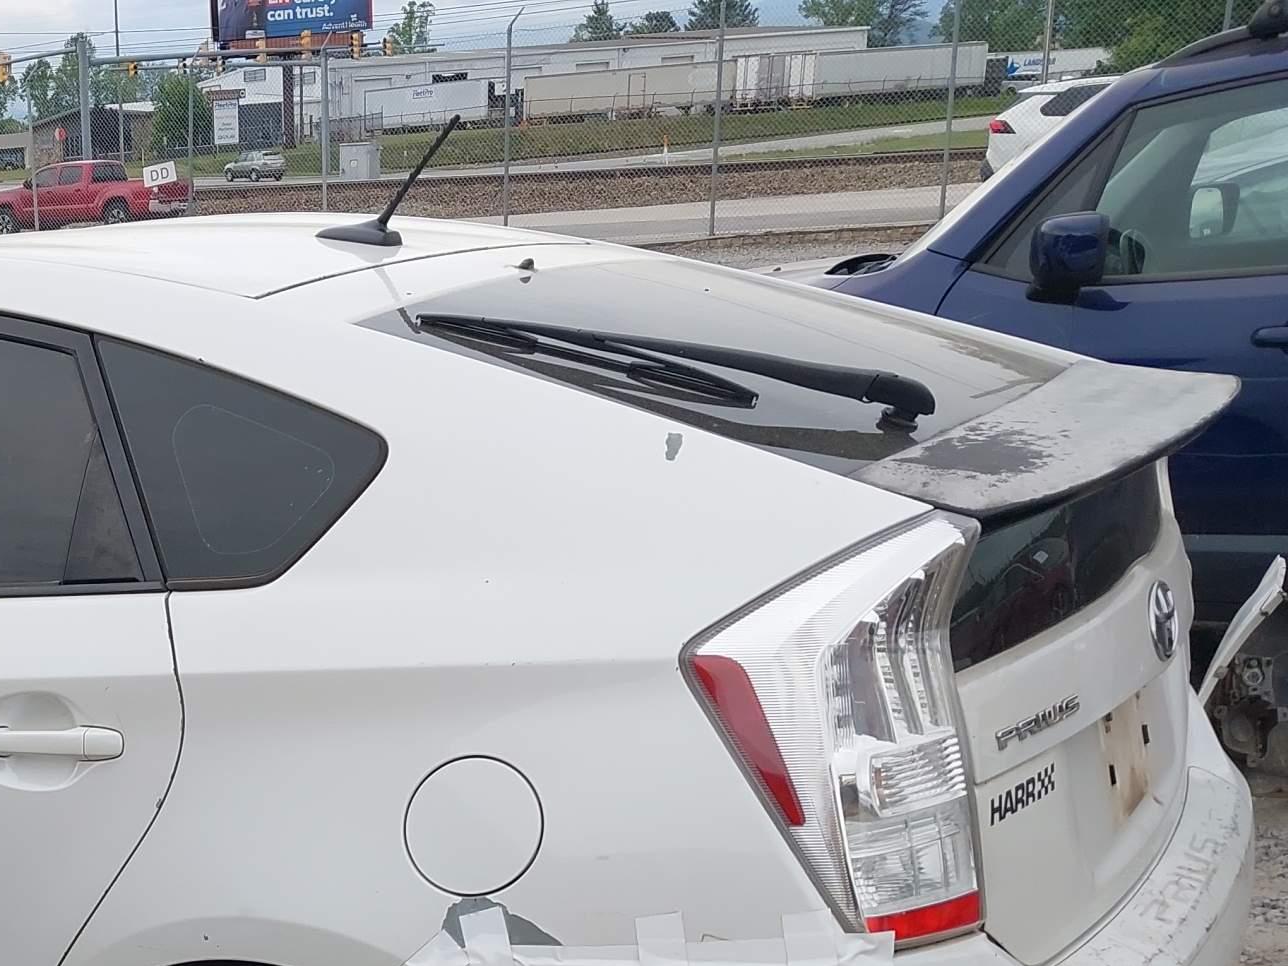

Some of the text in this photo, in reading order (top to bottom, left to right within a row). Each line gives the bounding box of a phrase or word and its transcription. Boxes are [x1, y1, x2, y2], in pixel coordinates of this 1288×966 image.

[267, 5, 334, 20] can trust.
[150, 167, 169, 181] DD
[995, 694, 1080, 751] PRIUS
